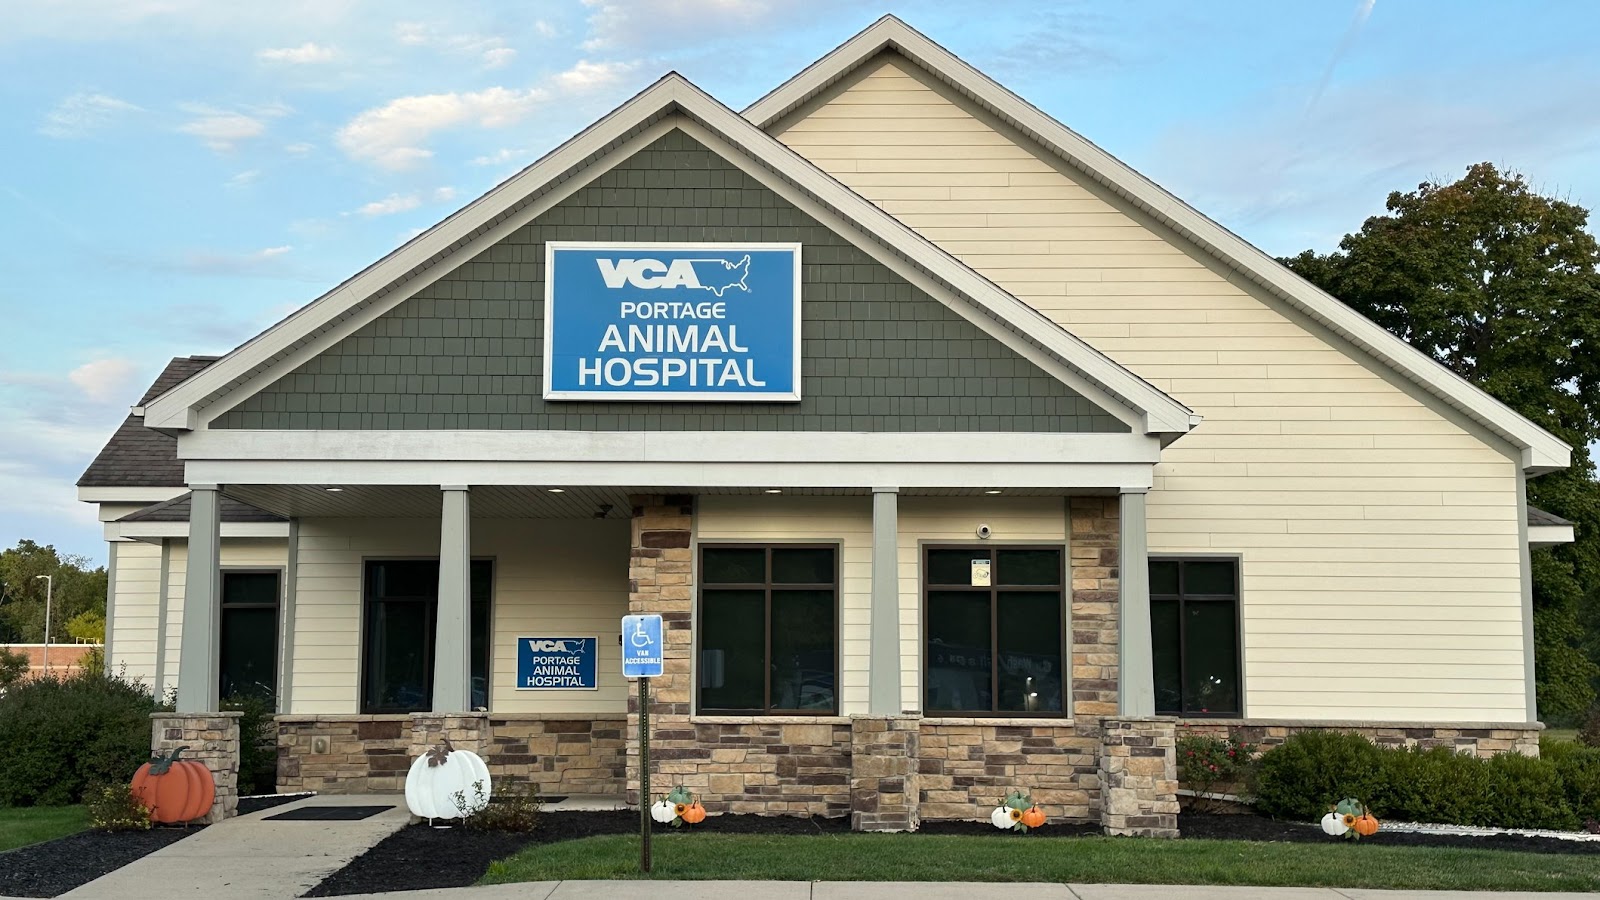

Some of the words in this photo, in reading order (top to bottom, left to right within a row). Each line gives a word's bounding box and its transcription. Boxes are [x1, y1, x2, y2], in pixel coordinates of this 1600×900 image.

[596, 258, 701, 289] VCA
[621, 302, 726, 319] PORTAGE
[598, 324, 749, 353] ANIMAL
[578, 357, 766, 387] HOSPITAL
[529, 640, 567, 652] VCA
[533, 656, 580, 665] PORTAGE
[533, 666, 580, 675] ANIMAL
[527, 676, 585, 686] HOSPITAL
